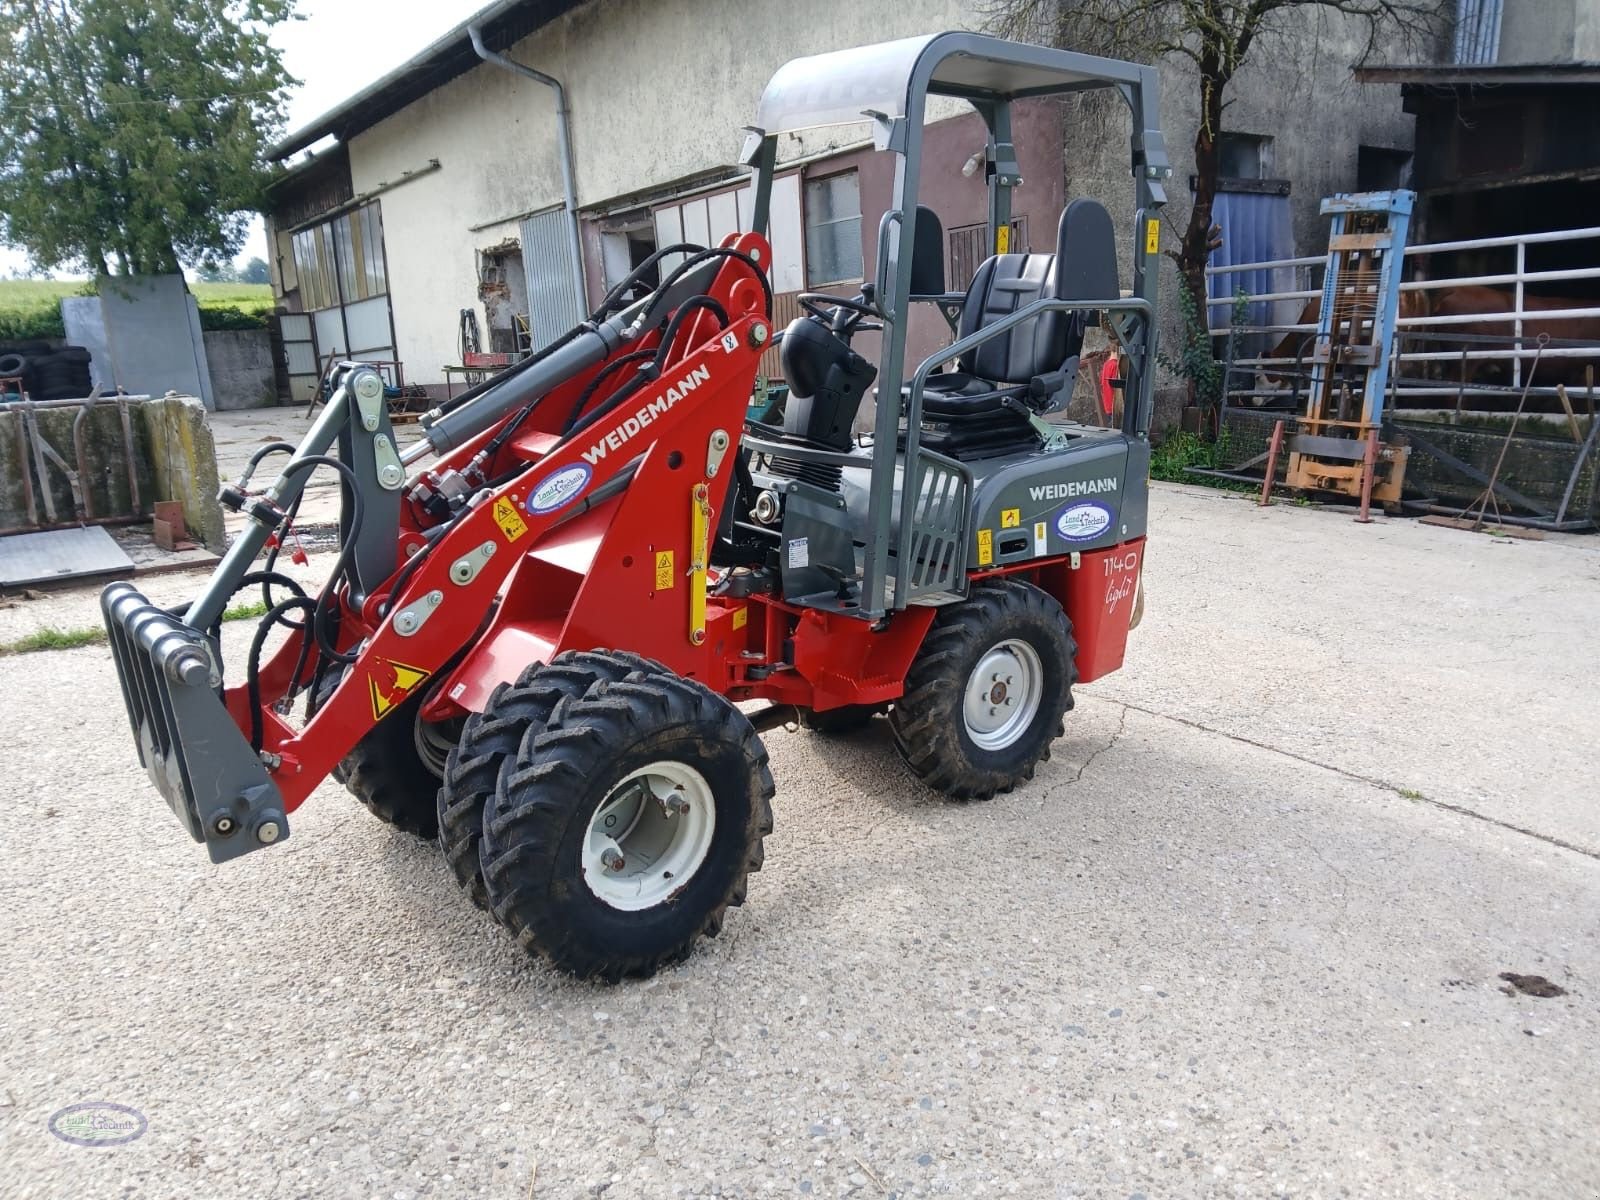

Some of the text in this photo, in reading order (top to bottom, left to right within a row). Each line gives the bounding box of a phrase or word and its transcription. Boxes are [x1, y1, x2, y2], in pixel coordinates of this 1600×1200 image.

[581, 364, 711, 465] WEIDEMANN
[538, 486, 555, 501] Land
[560, 472, 585, 491] Technik
[1029, 477, 1117, 501] WEIDEMANN
[1103, 552, 1137, 577] 1140
[1105, 576, 1133, 614] light
